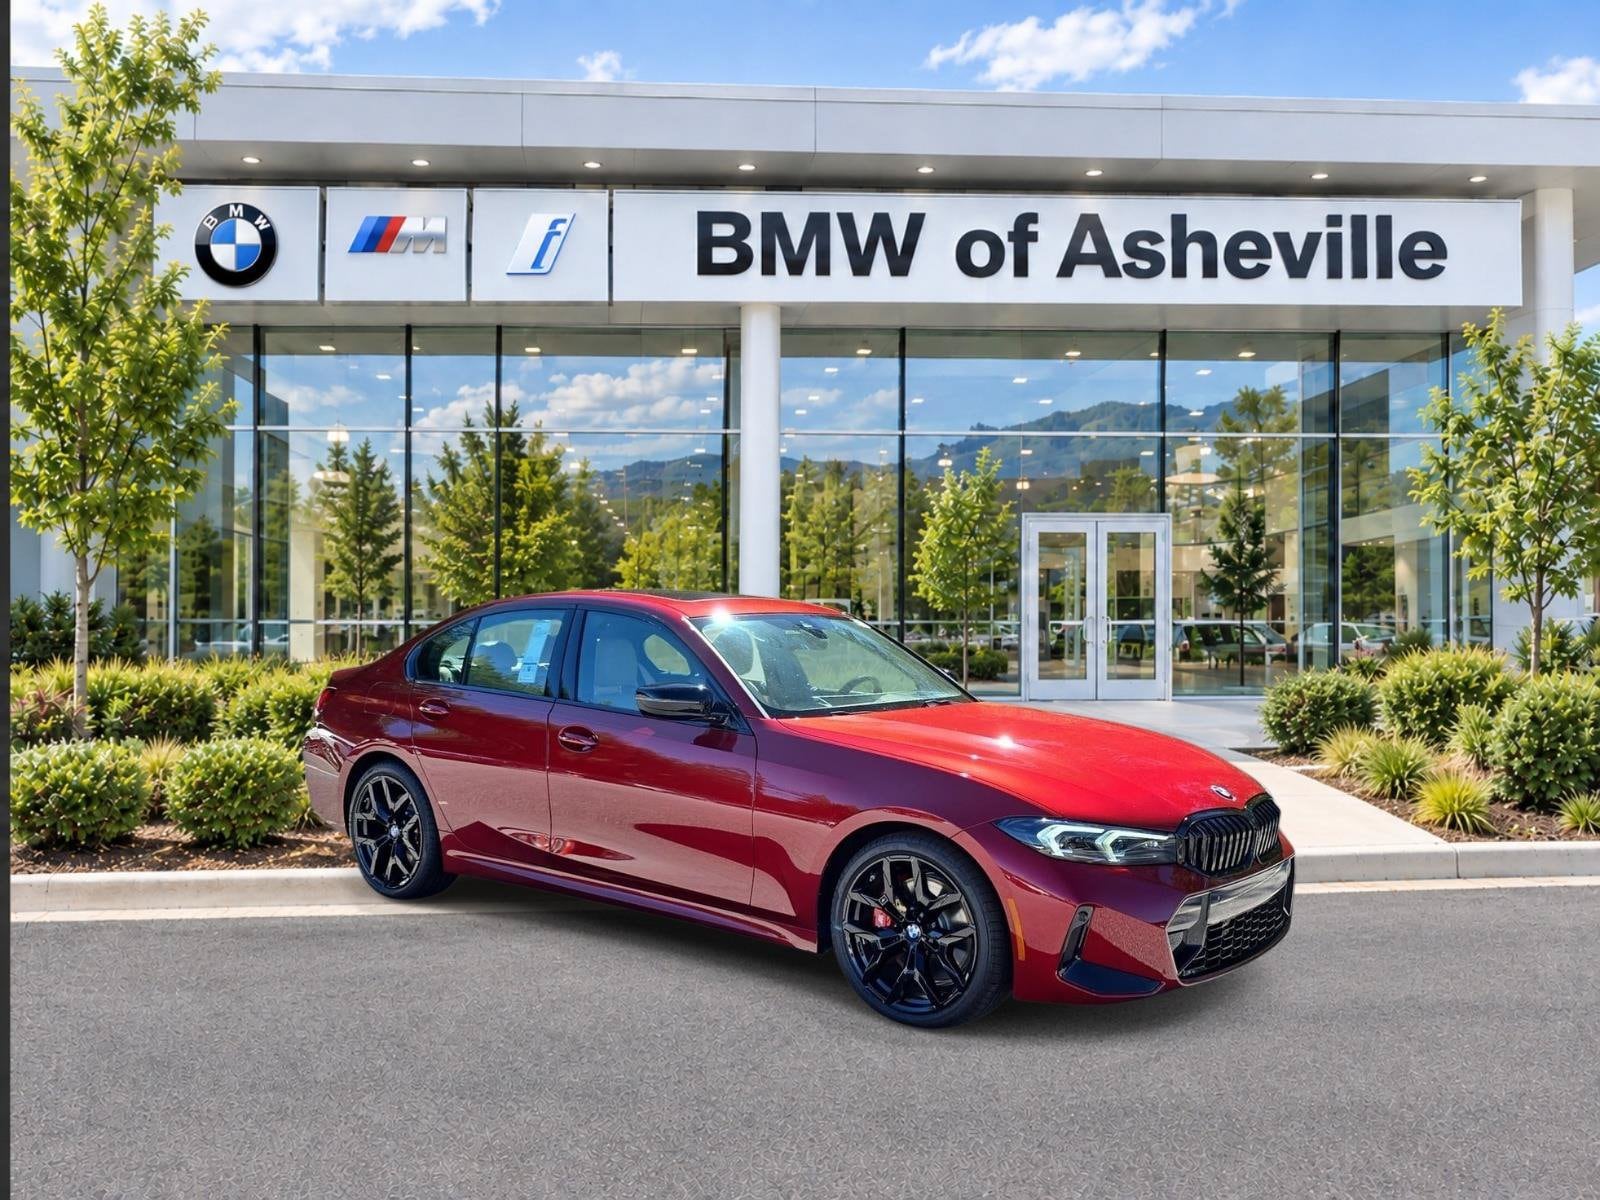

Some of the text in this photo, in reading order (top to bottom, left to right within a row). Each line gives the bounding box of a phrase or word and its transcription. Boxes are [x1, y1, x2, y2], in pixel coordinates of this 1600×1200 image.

[203, 204, 270, 231] BMW
[389, 215, 448, 254] M
[696, 210, 1448, 281] BMW of Asheville
